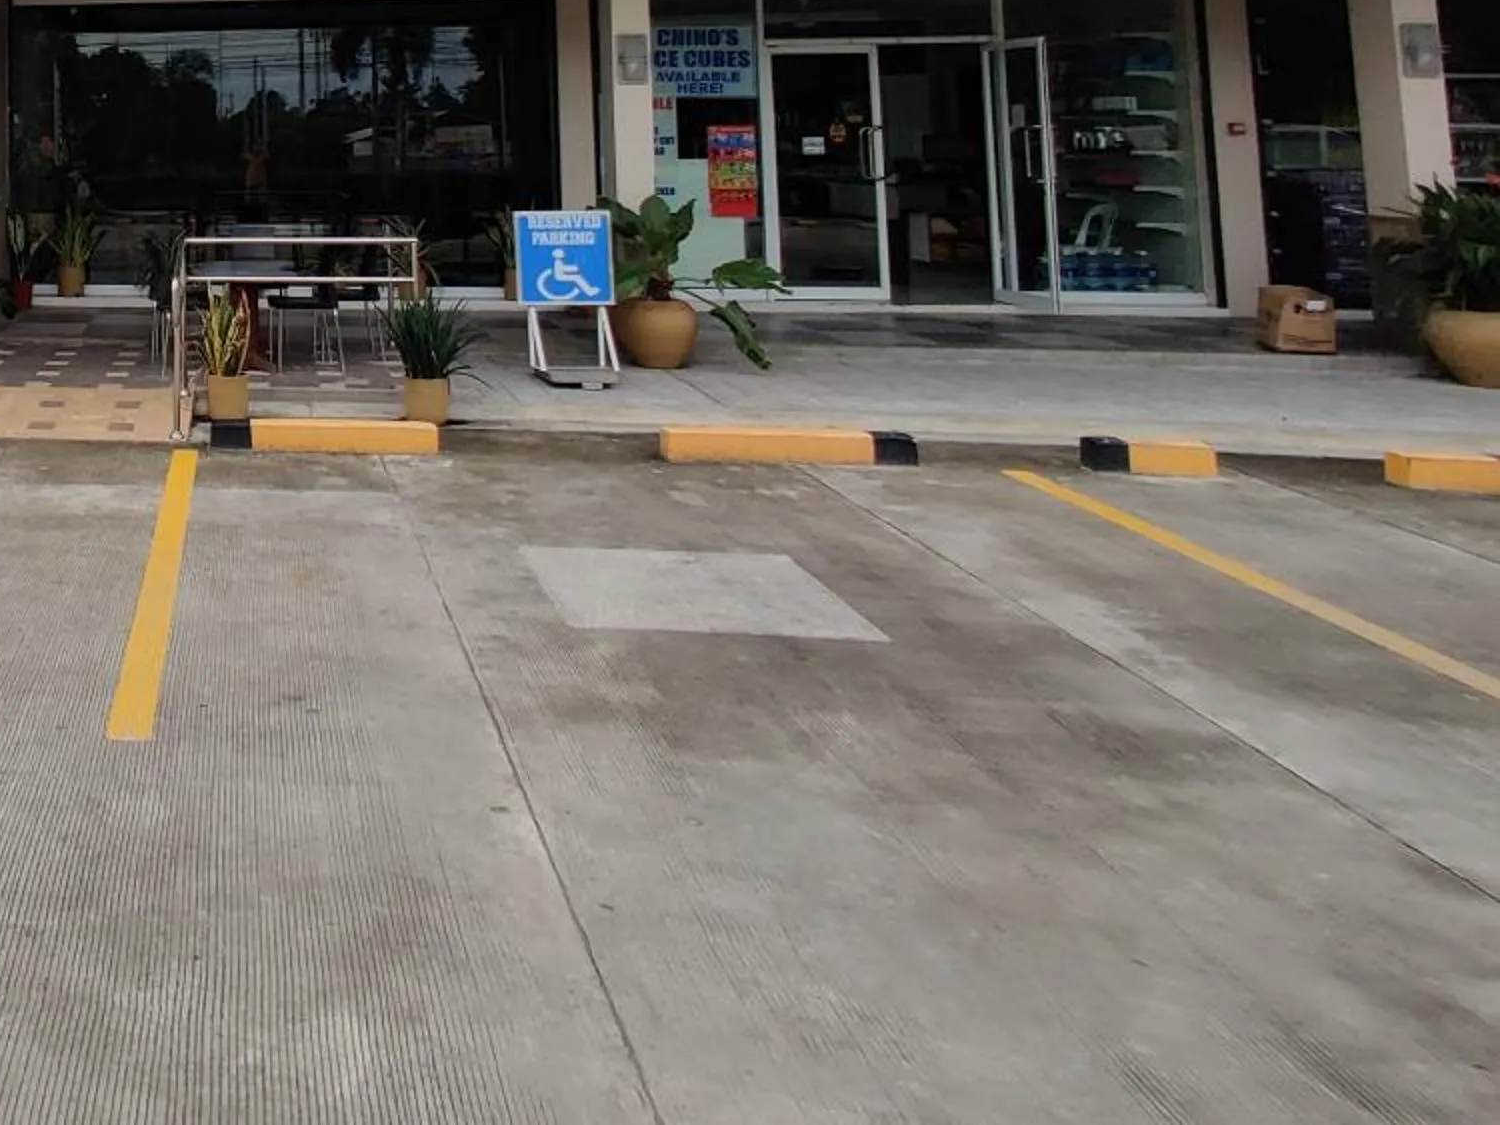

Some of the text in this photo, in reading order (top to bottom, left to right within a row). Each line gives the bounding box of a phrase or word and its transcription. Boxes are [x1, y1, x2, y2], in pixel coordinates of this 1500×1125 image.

[657, 28, 740, 46] CHINO'S
[653, 50, 751, 69] CE CUBES
[655, 70, 741, 83] AVAILABLE
[676, 82, 725, 94] HERE!
[527, 215, 602, 230] RESERVED
[531, 231, 596, 246] PARKING
